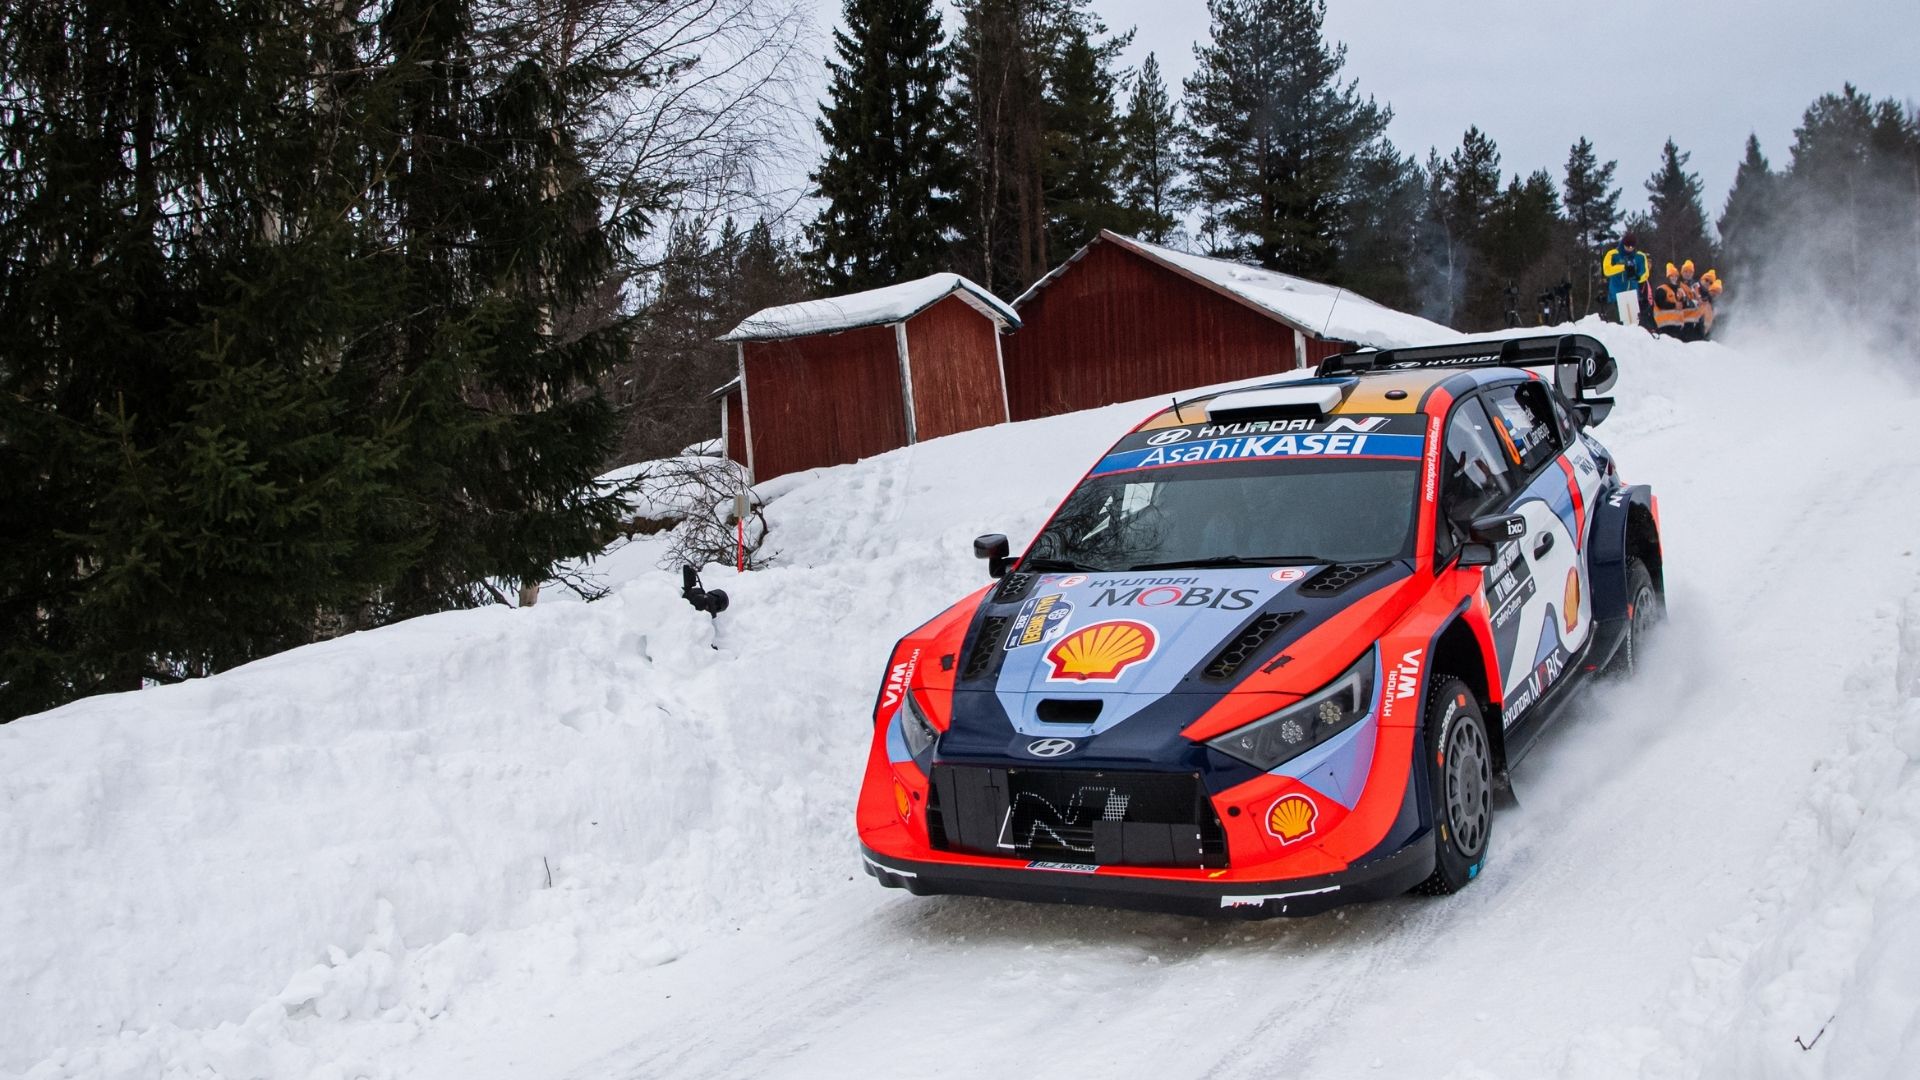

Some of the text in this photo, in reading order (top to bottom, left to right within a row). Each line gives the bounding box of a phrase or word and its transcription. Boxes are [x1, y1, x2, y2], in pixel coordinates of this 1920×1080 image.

[1197, 419, 1316, 438] HYUNDAI
[1426, 417, 1441, 502] motorsport.hyundai.com
[1089, 577, 1200, 588] HYUNDAI
[1089, 586, 1262, 610] MOBIS
[903, 648, 920, 687] HYUNDAI
[1383, 670, 1398, 717] HYUNDAI
[1502, 648, 1563, 729] HYUNDAI MOBIS
